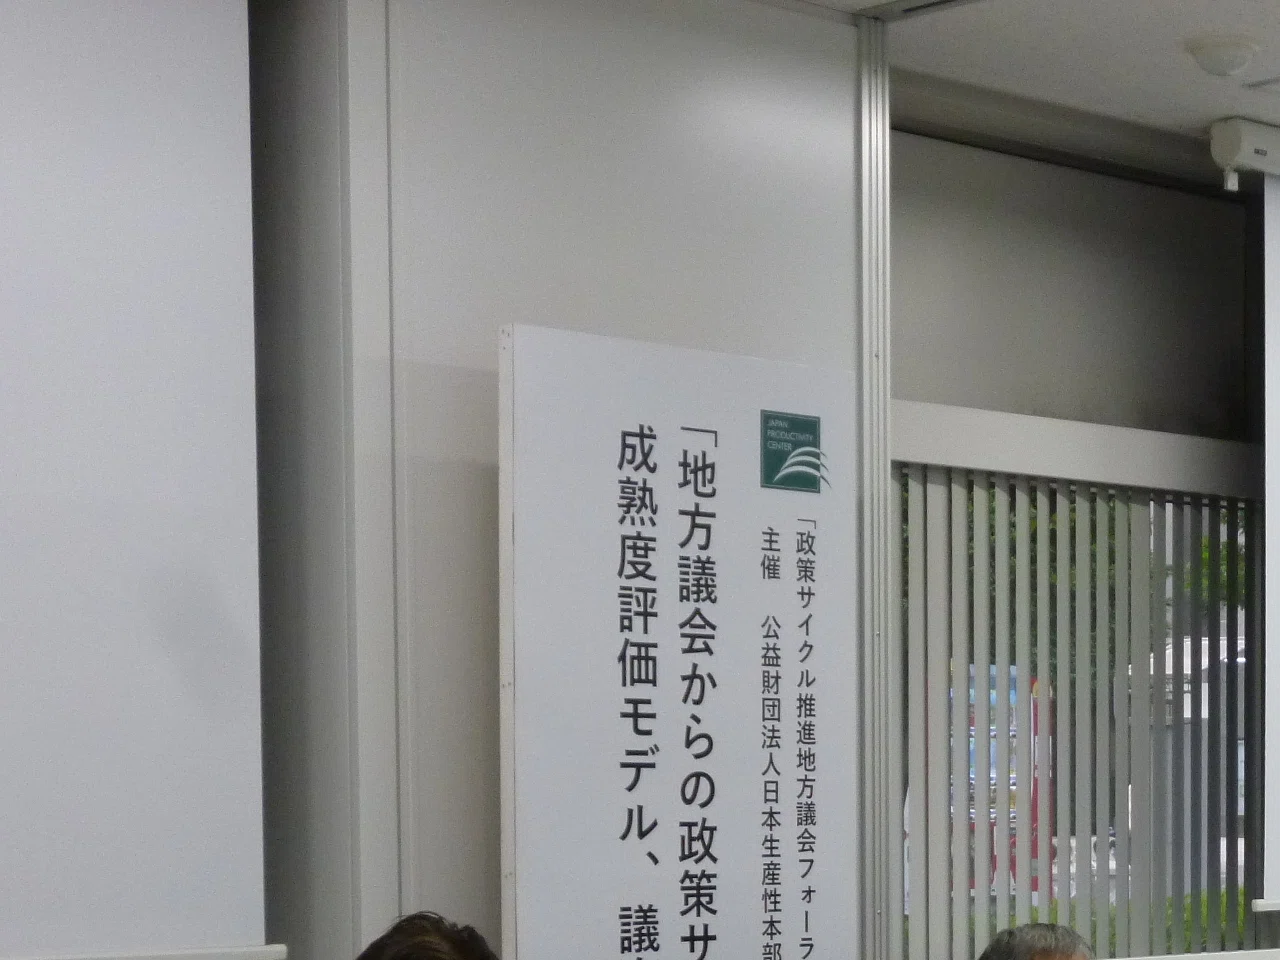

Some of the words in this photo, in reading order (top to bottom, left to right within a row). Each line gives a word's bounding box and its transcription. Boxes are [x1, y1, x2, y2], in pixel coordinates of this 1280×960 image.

[767, 419, 788, 428] JAPAN
[767, 441, 792, 451] CENTER
[761, 526, 782, 580] 主催
